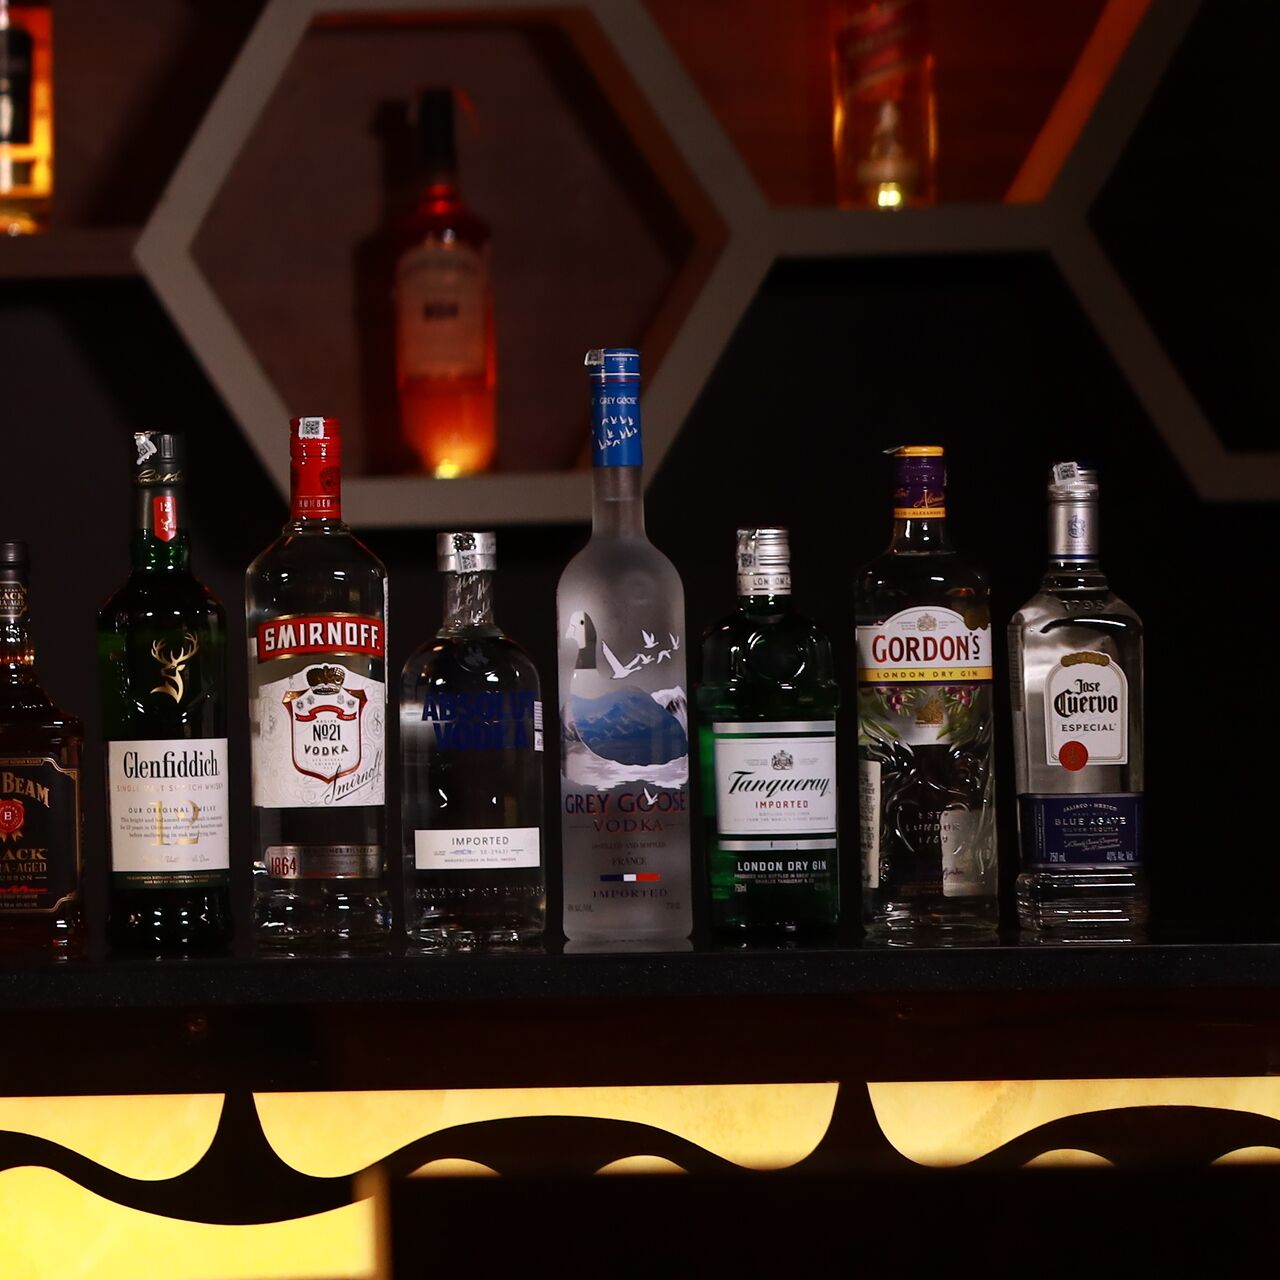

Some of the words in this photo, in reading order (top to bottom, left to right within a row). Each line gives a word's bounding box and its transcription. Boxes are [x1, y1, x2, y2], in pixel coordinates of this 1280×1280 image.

[616, 396, 638, 405] GOOSE
[159, 501, 172, 512] 12
[265, 621, 380, 651] SMIRNOFF
[872, 632, 980, 663] GORDON'S
[877, 670, 925, 679] LONDON
[1074, 678, 1100, 695] Jose
[1053, 688, 1119, 718] Cuervo
[1061, 723, 1115, 732] ESPECIAL
[304, 744, 349, 756] VODKA
[123, 750, 220, 779] Glenfiddich
[324, 750, 383, 805] Smirnoff
[1, 771, 51, 809] BEAM
[728, 771, 831, 798] Tanqueray
[565, 793, 609, 814] GREY
[617, 791, 686, 813] GOOSE
[755, 800, 809, 809] IMPORTED
[4, 811, 12, 821] B
[1054, 818, 1085, 826] BLUE
[1089, 817, 1126, 826] AGAVE
[592, 819, 663, 833] VODKA
[451, 836, 510, 846] IMPORTED
[271, 856, 296, 875] 1864
[612, 857, 648, 865] FRANCE
[737, 861, 783, 872] LONDON
[787, 861, 809, 871] DRY
[812, 860, 827, 870] GIN
[592, 888, 669, 899] IMPORTED
